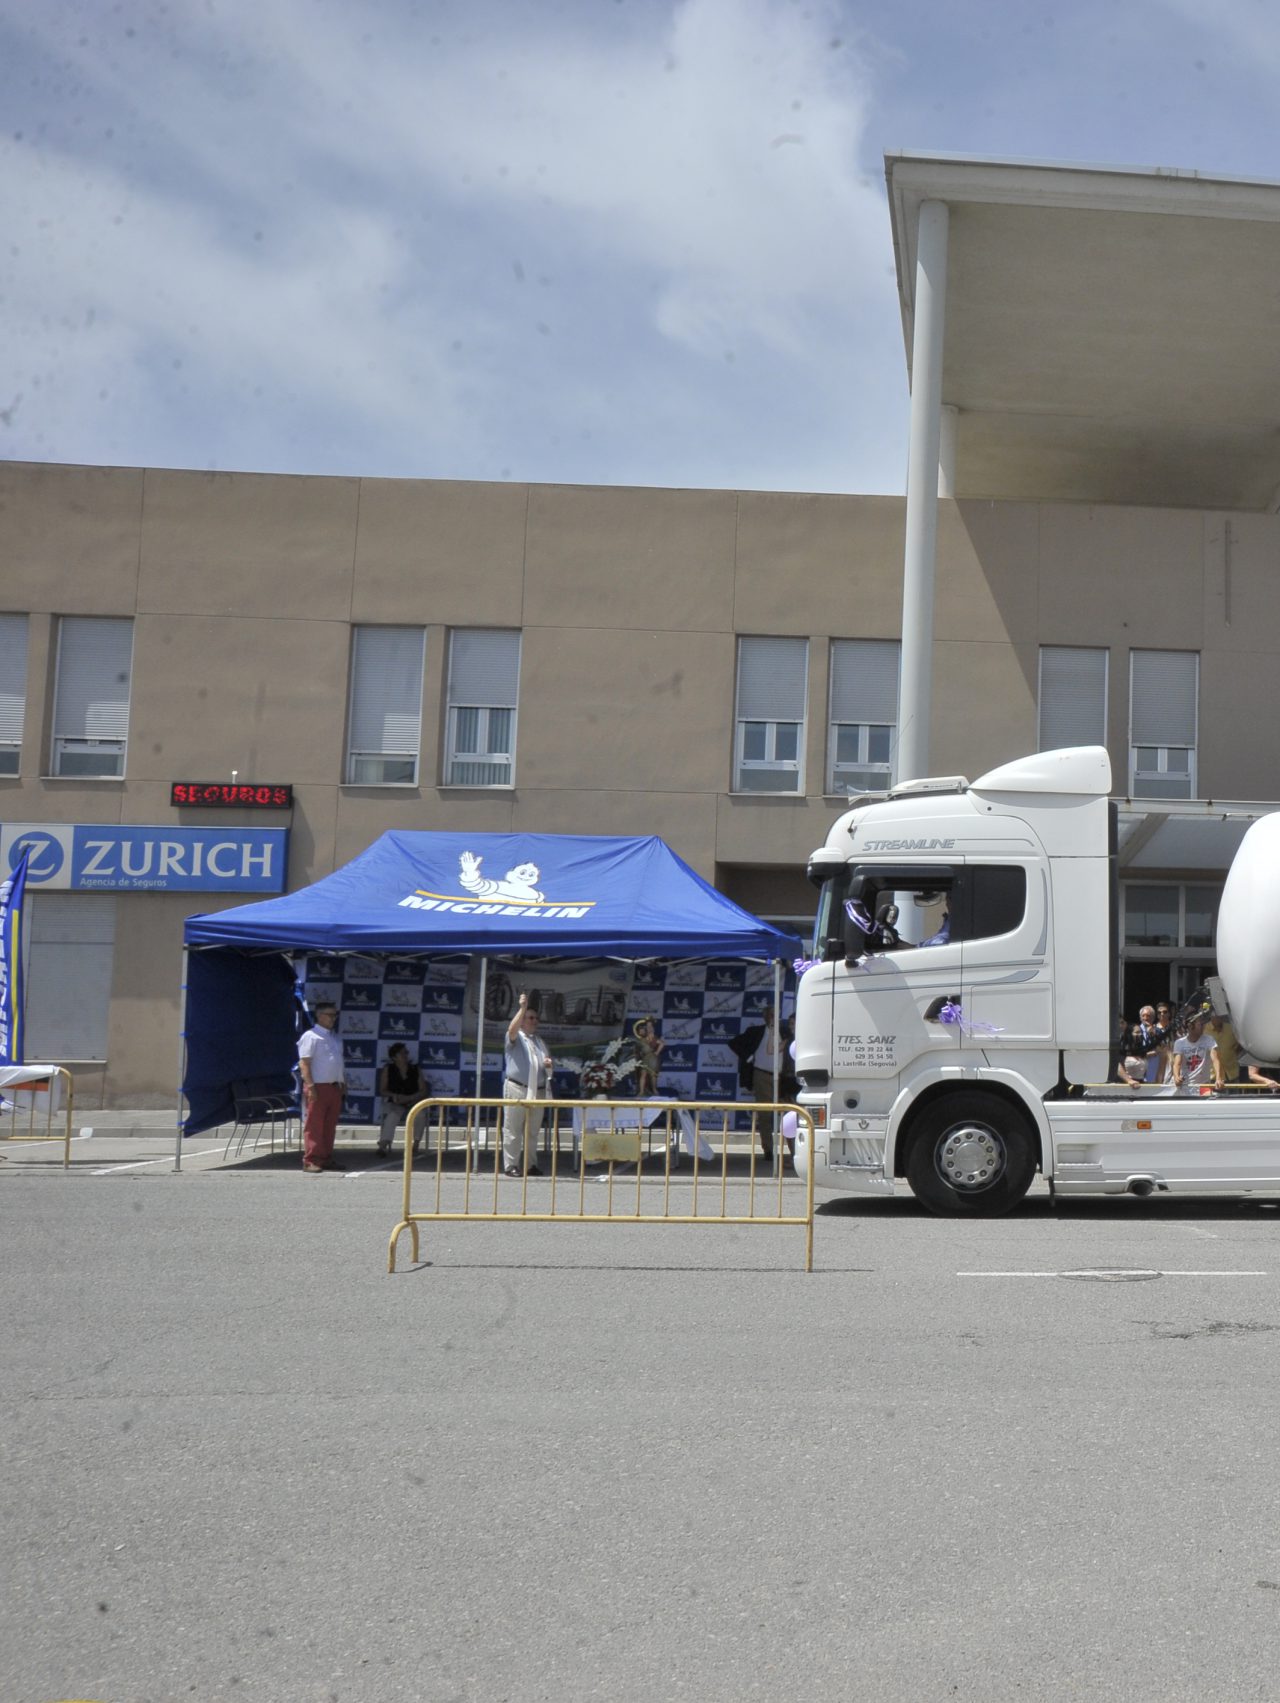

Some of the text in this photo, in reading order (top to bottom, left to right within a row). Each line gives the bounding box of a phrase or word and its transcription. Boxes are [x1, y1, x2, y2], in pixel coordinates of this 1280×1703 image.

[862, 839, 956, 852] STREAMLINE
[81, 840, 274, 877] ZURICH
[80, 877, 167, 888] Agencia de Seguros
[398, 895, 591, 918] MICHELIN
[837, 1035, 897, 1045] TTES. SANZ
